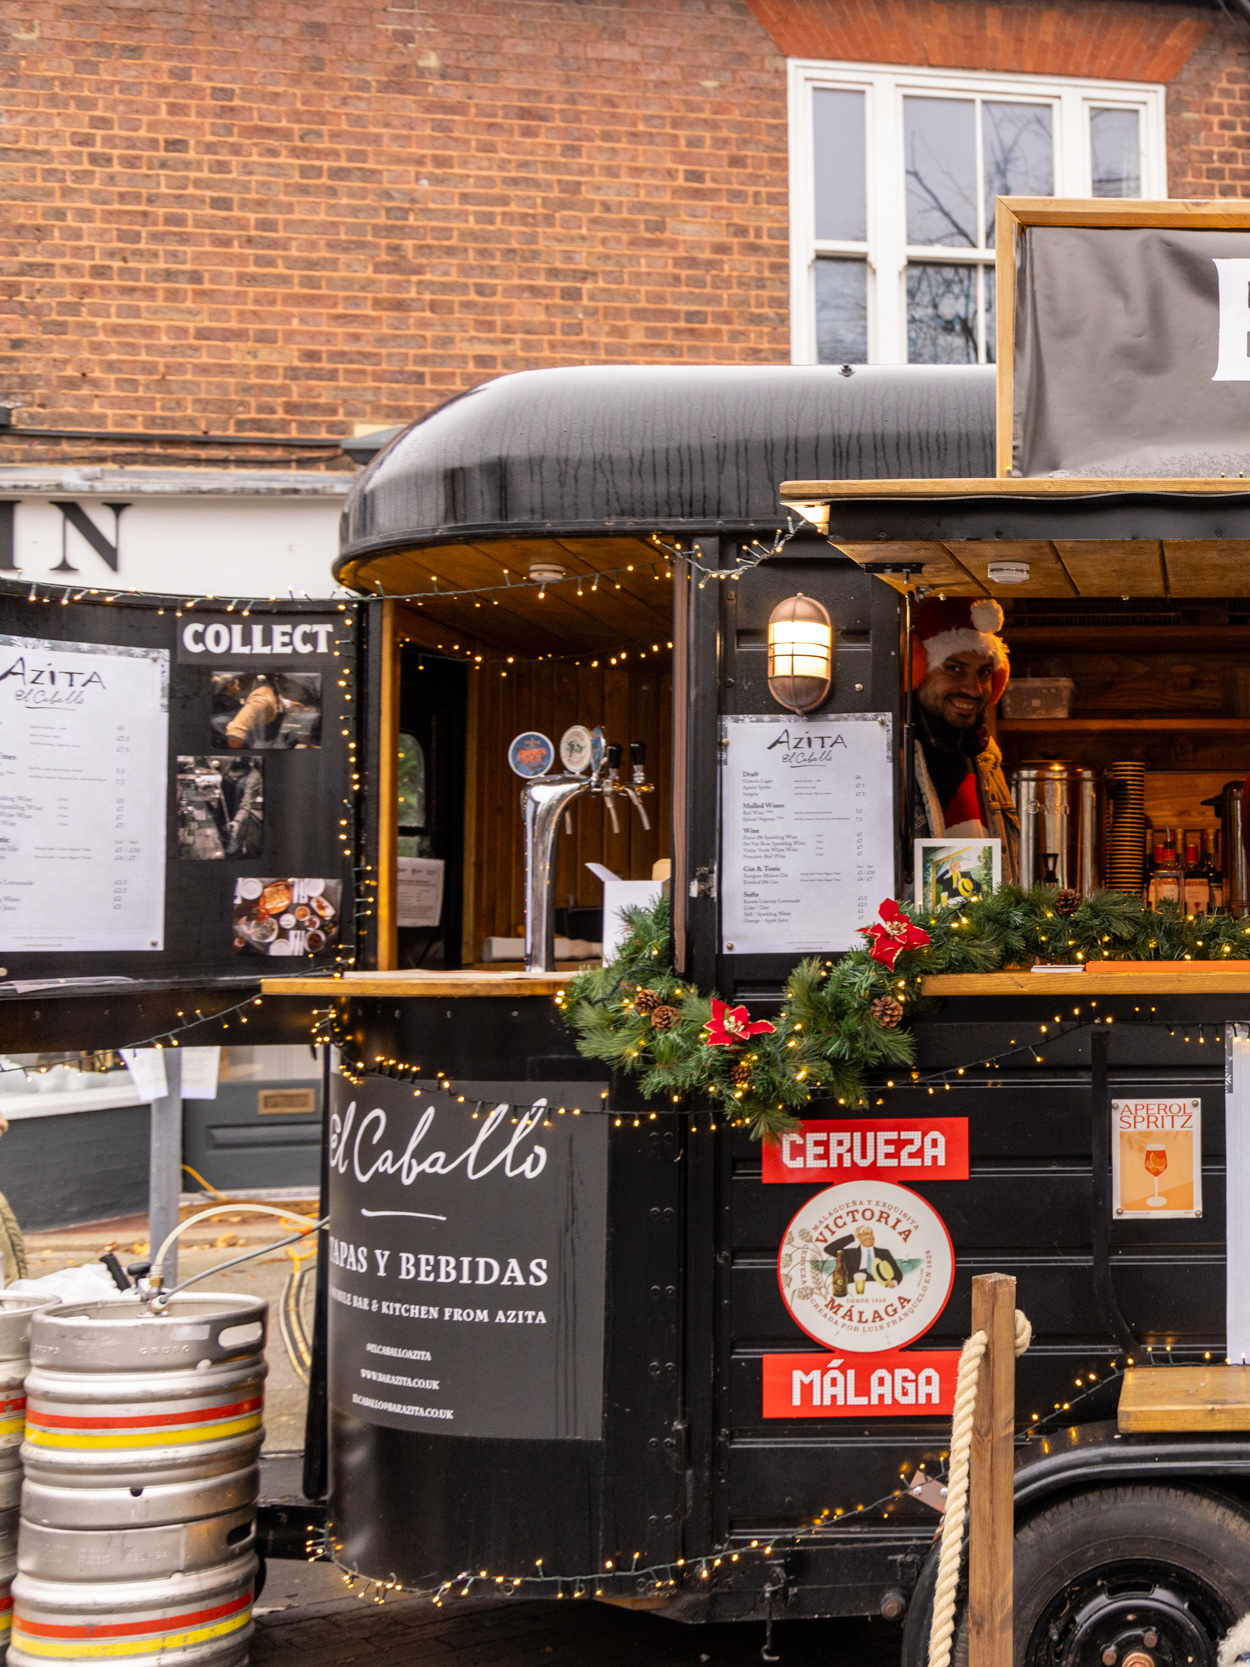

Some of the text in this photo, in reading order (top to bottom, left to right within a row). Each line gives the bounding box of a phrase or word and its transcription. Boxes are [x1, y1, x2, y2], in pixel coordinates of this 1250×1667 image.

[182, 623, 334, 654] COLLECT
[1120, 1103, 1193, 1116] APEROL
[1120, 1115, 1193, 1129] SPRITZ
[354, 1098, 547, 1186] Caballo
[782, 1131, 946, 1169] CERVEZA
[812, 1200, 864, 1231] MALAGUEÑA
[875, 1200, 920, 1230] EXQUISITA
[815, 1208, 913, 1244] VICTORIA
[374, 1249, 390, 1276] Y
[399, 1253, 548, 1286] BEBIDAS
[800, 1244, 808, 1285] CERVEZA
[352, 1295, 369, 1311] BAR
[371, 1300, 379, 1312] &
[381, 1301, 439, 1319] KITCHEN
[444, 1307, 488, 1322] FROM
[495, 1310, 546, 1324] AZITA
[810, 1298, 838, 1326] CREADA
[841, 1323, 859, 1332] POR
[863, 1325, 884, 1333] LUIS
[886, 1286, 928, 1329] FRANQUELO
[824, 1295, 912, 1324] MÁLAGA
[792, 1359, 940, 1406] MÁLAGA
